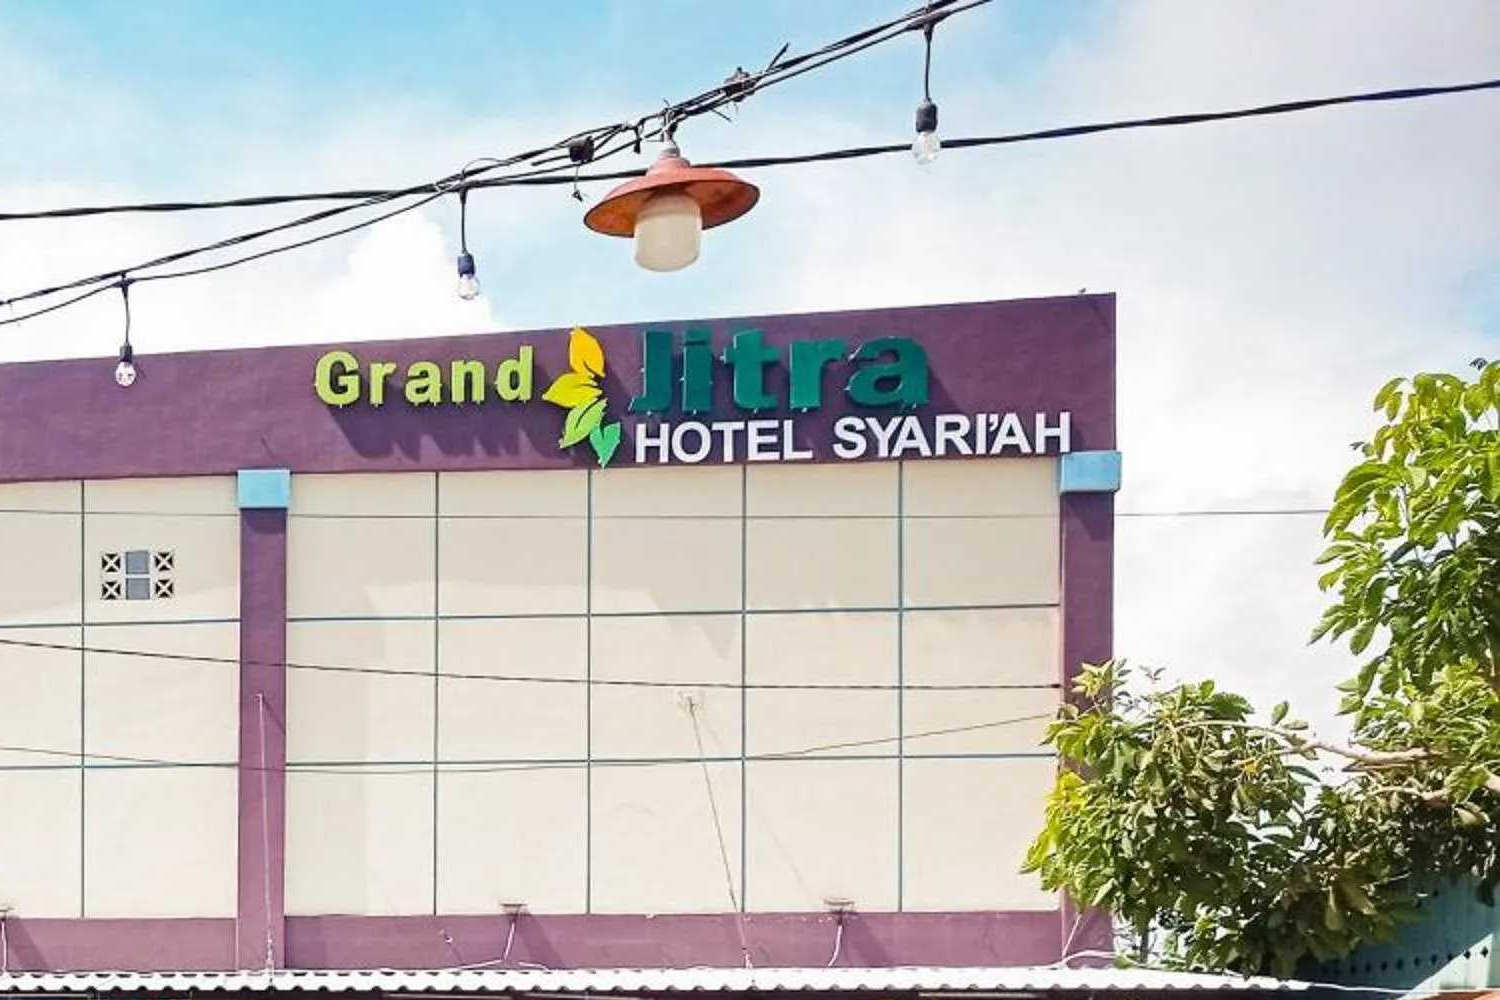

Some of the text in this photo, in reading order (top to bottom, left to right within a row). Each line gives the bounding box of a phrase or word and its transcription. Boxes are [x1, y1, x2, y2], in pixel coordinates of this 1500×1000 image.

[314, 328, 929, 414] Grand Jitra
[635, 411, 1072, 464] HOTEL SYARI'AH
